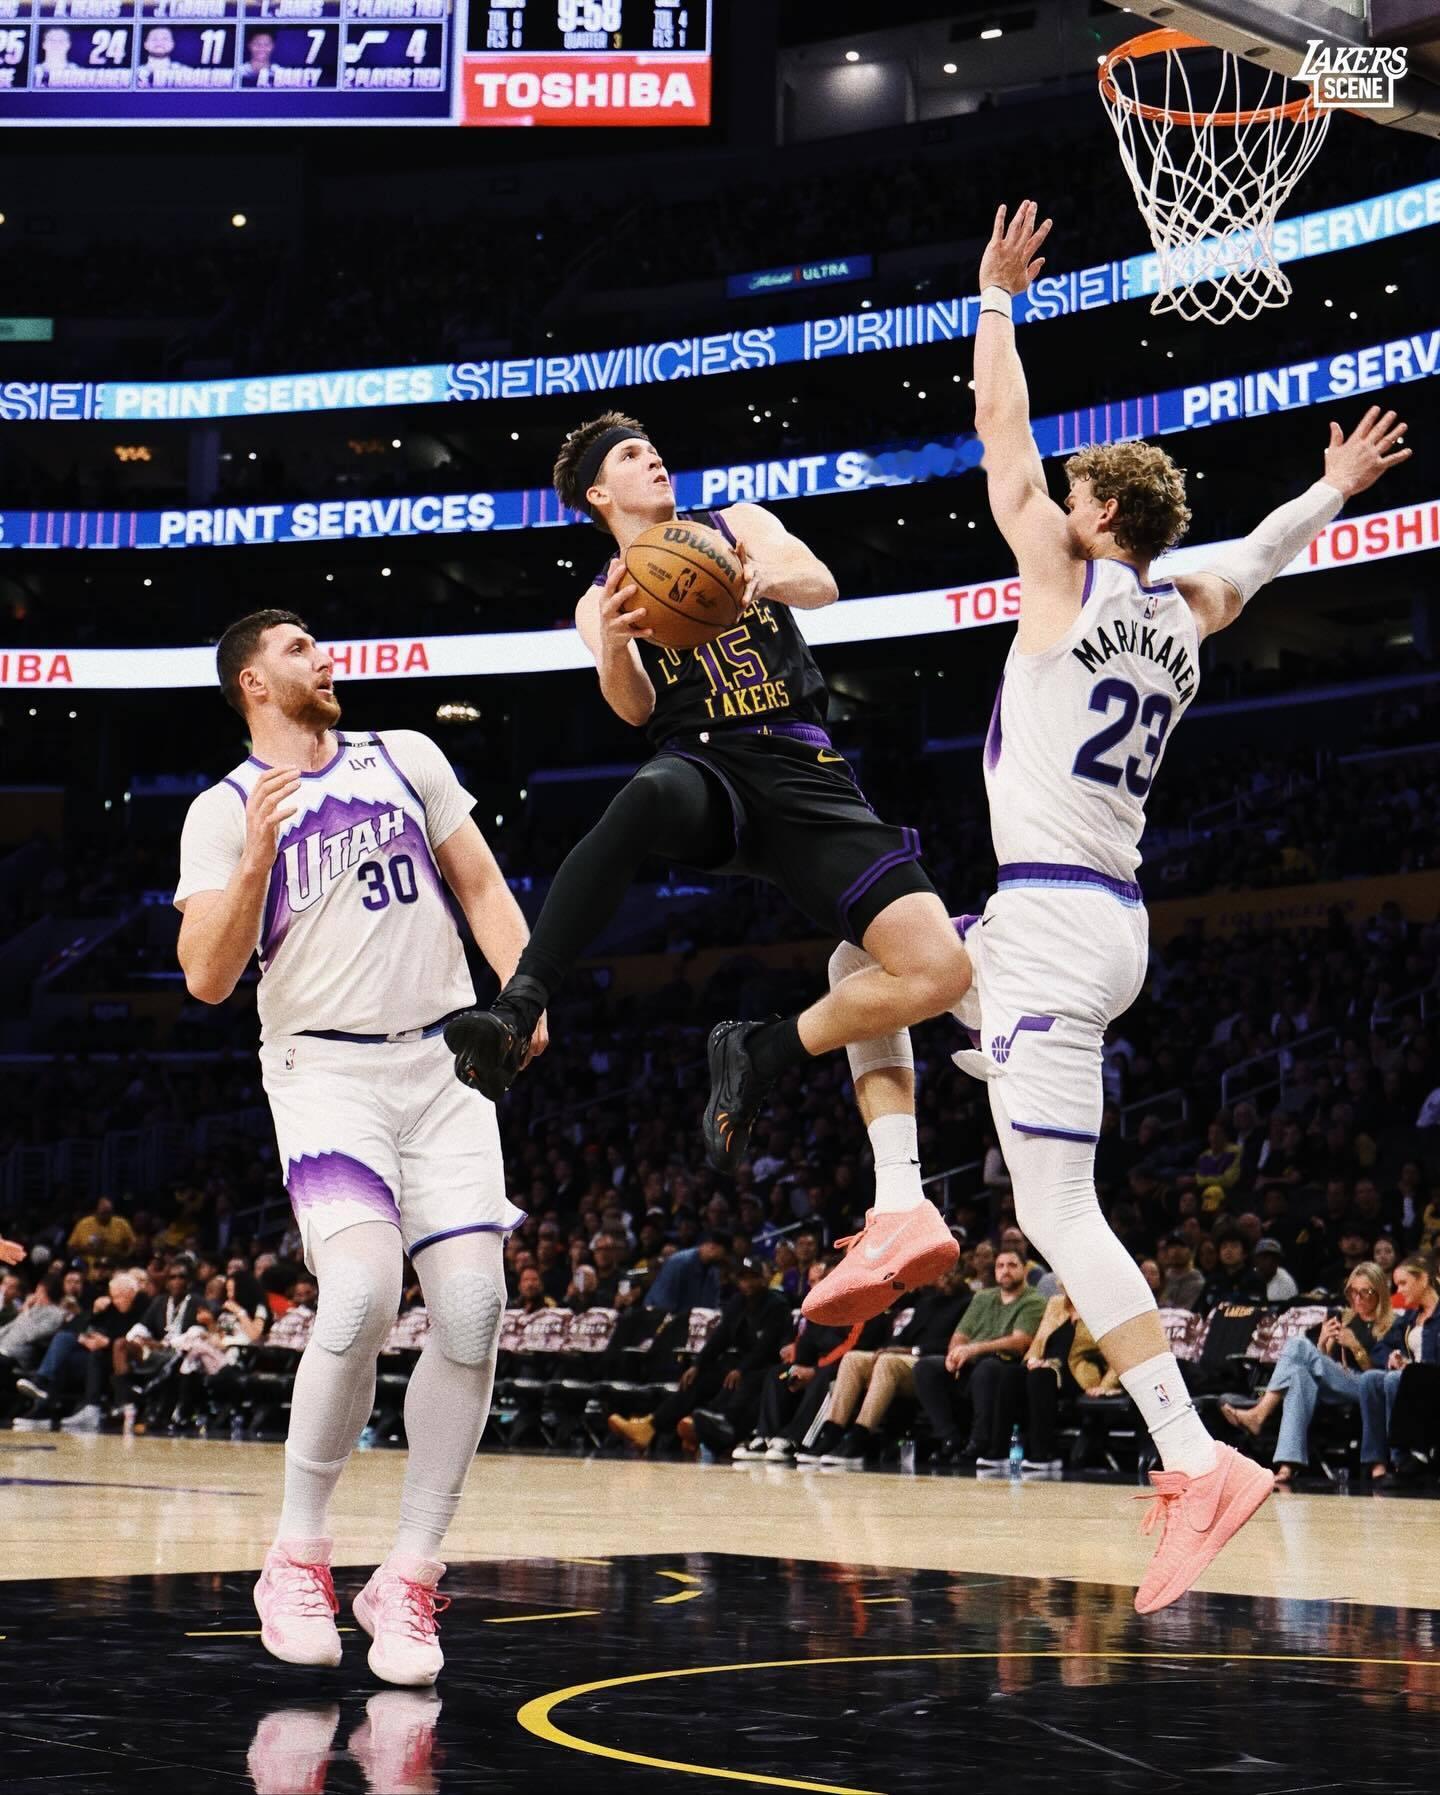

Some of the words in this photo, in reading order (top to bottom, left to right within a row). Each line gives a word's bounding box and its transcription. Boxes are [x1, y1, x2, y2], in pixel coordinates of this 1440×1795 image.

[88, 29, 127, 64] 24
[200, 29, 226, 64] 11
[305, 29, 326, 64] 7
[405, 29, 427, 64] 4
[475, 73, 695, 108] TOSHIBA
[803, 262, 848, 280] ULTRA
[115, 387, 242, 418] PRINT
[245, 371, 433, 414] SERVICES
[446, 326, 776, 402] SERVICES
[1184, 362, 1318, 426] PRINT
[703, 456, 827, 504] PRINT
[160, 506, 283, 544] PRINT
[291, 493, 495, 539] SERVICES
[664, 527, 737, 584] Wilson
[694, 624, 768, 697] 15
[1071, 677, 1173, 798] 23
[283, 807, 405, 912] UTAH
[357, 854, 419, 912] 30
